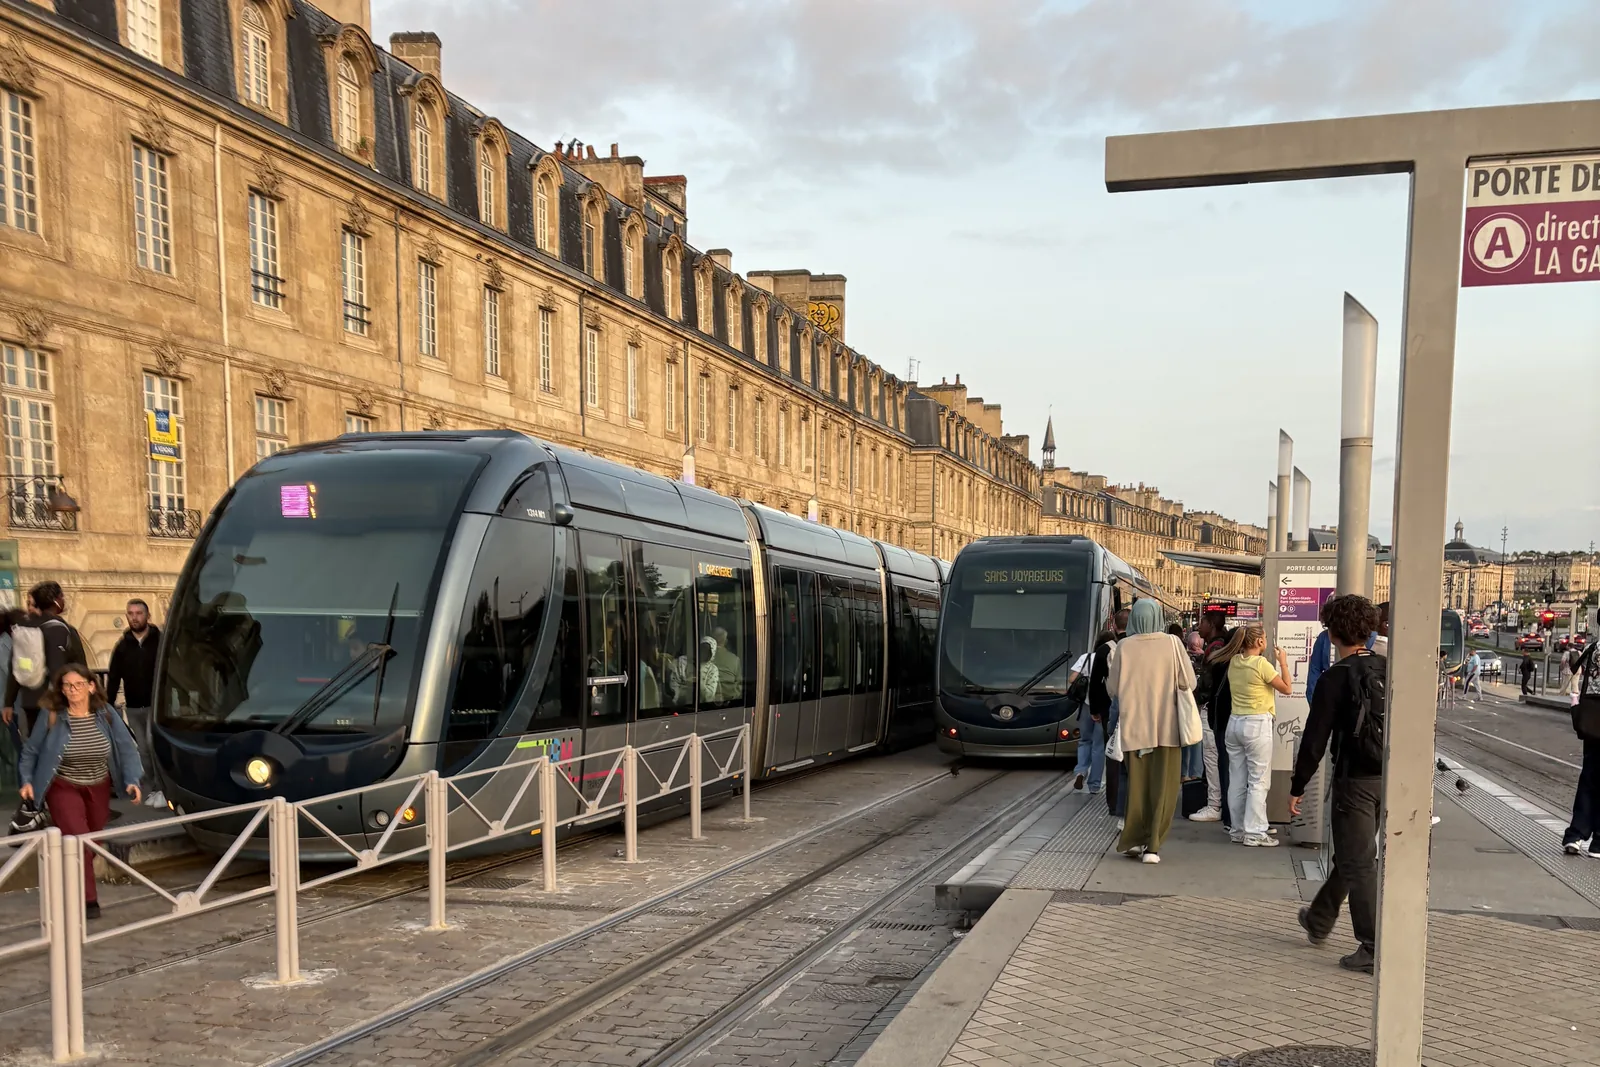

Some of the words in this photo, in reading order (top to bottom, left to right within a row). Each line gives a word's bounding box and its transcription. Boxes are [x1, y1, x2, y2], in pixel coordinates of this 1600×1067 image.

[1472, 165, 1562, 198] PORTE
[1534, 246, 1562, 276] LA
[1571, 244, 1600, 274] GA
[984, 570, 1008, 582] SANS
[1011, 569, 1064, 582] VOYAGEURS
